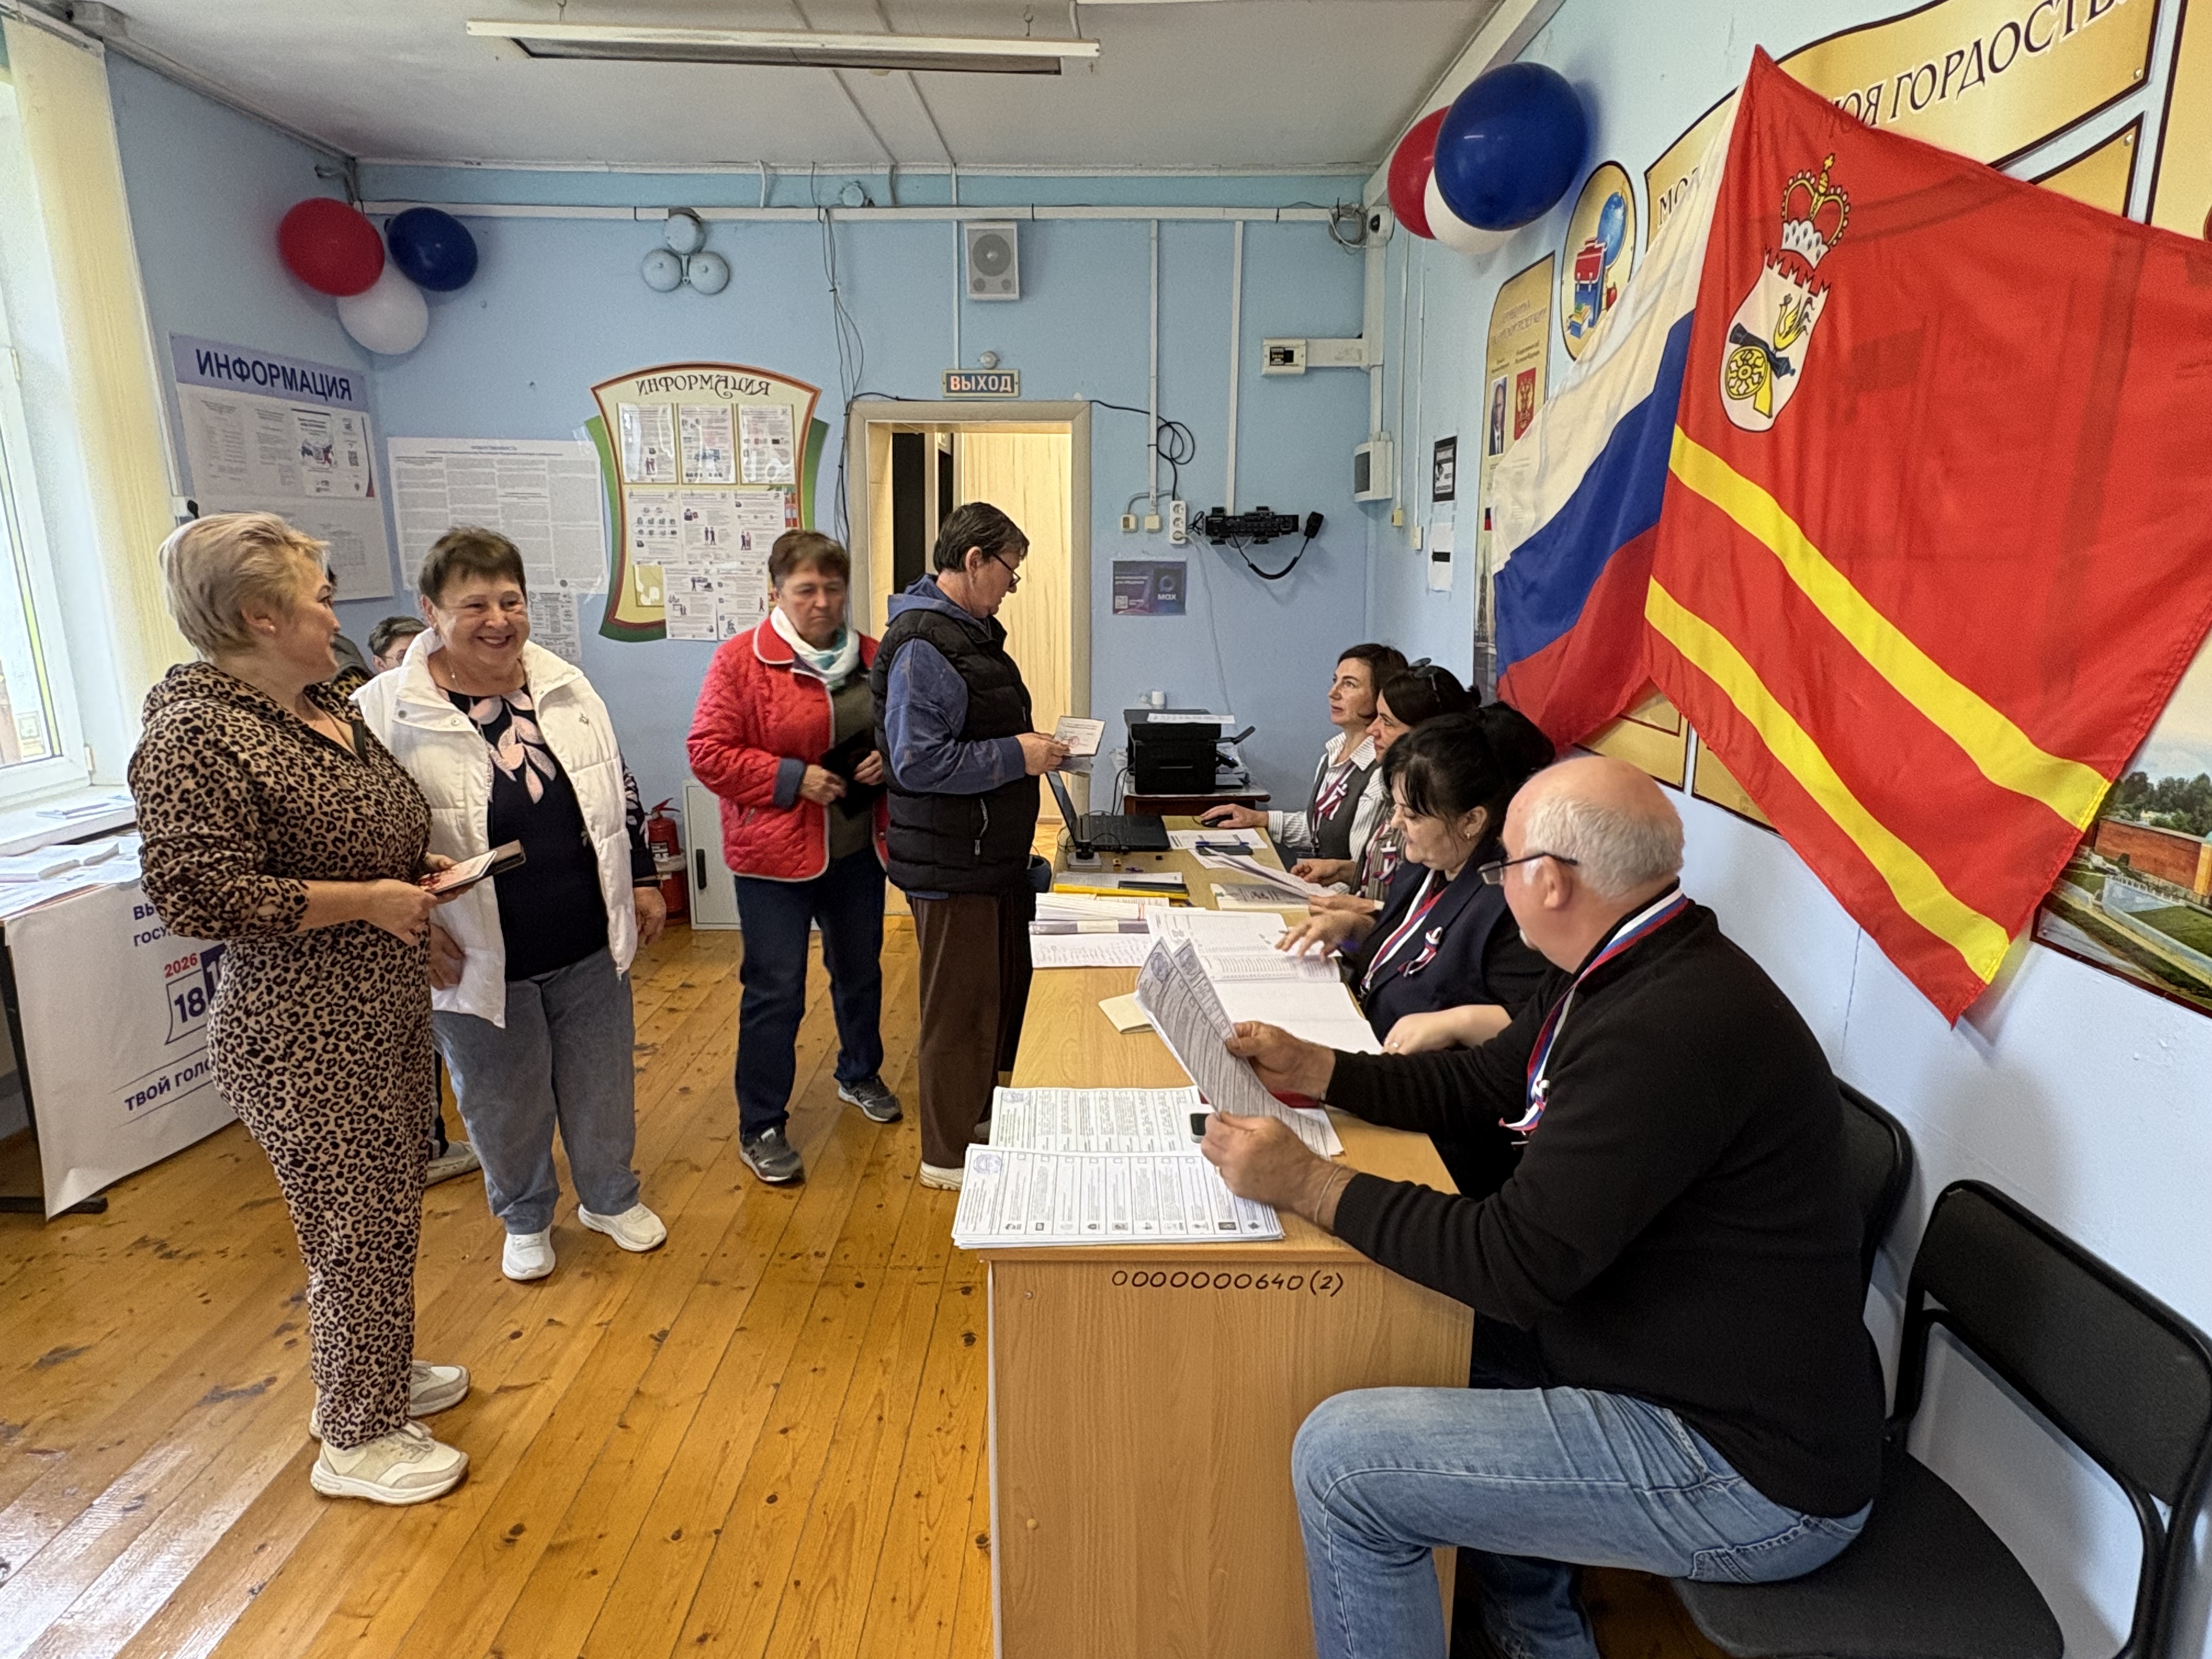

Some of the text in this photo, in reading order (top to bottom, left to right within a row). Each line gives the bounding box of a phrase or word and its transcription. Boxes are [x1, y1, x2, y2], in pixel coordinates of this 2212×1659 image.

[1833, 82, 1884, 127] ОЯ
[195, 348, 353, 402] ИНФОРМАЦИЯ
[635, 374, 772, 399] ИНФОРМАЦИЯ
[950, 375, 1012, 392] ВЫХОД
[164, 952, 198, 978] 2026
[174, 987, 206, 1023] 18
[124, 1075, 171, 1111] ТВОЙ
